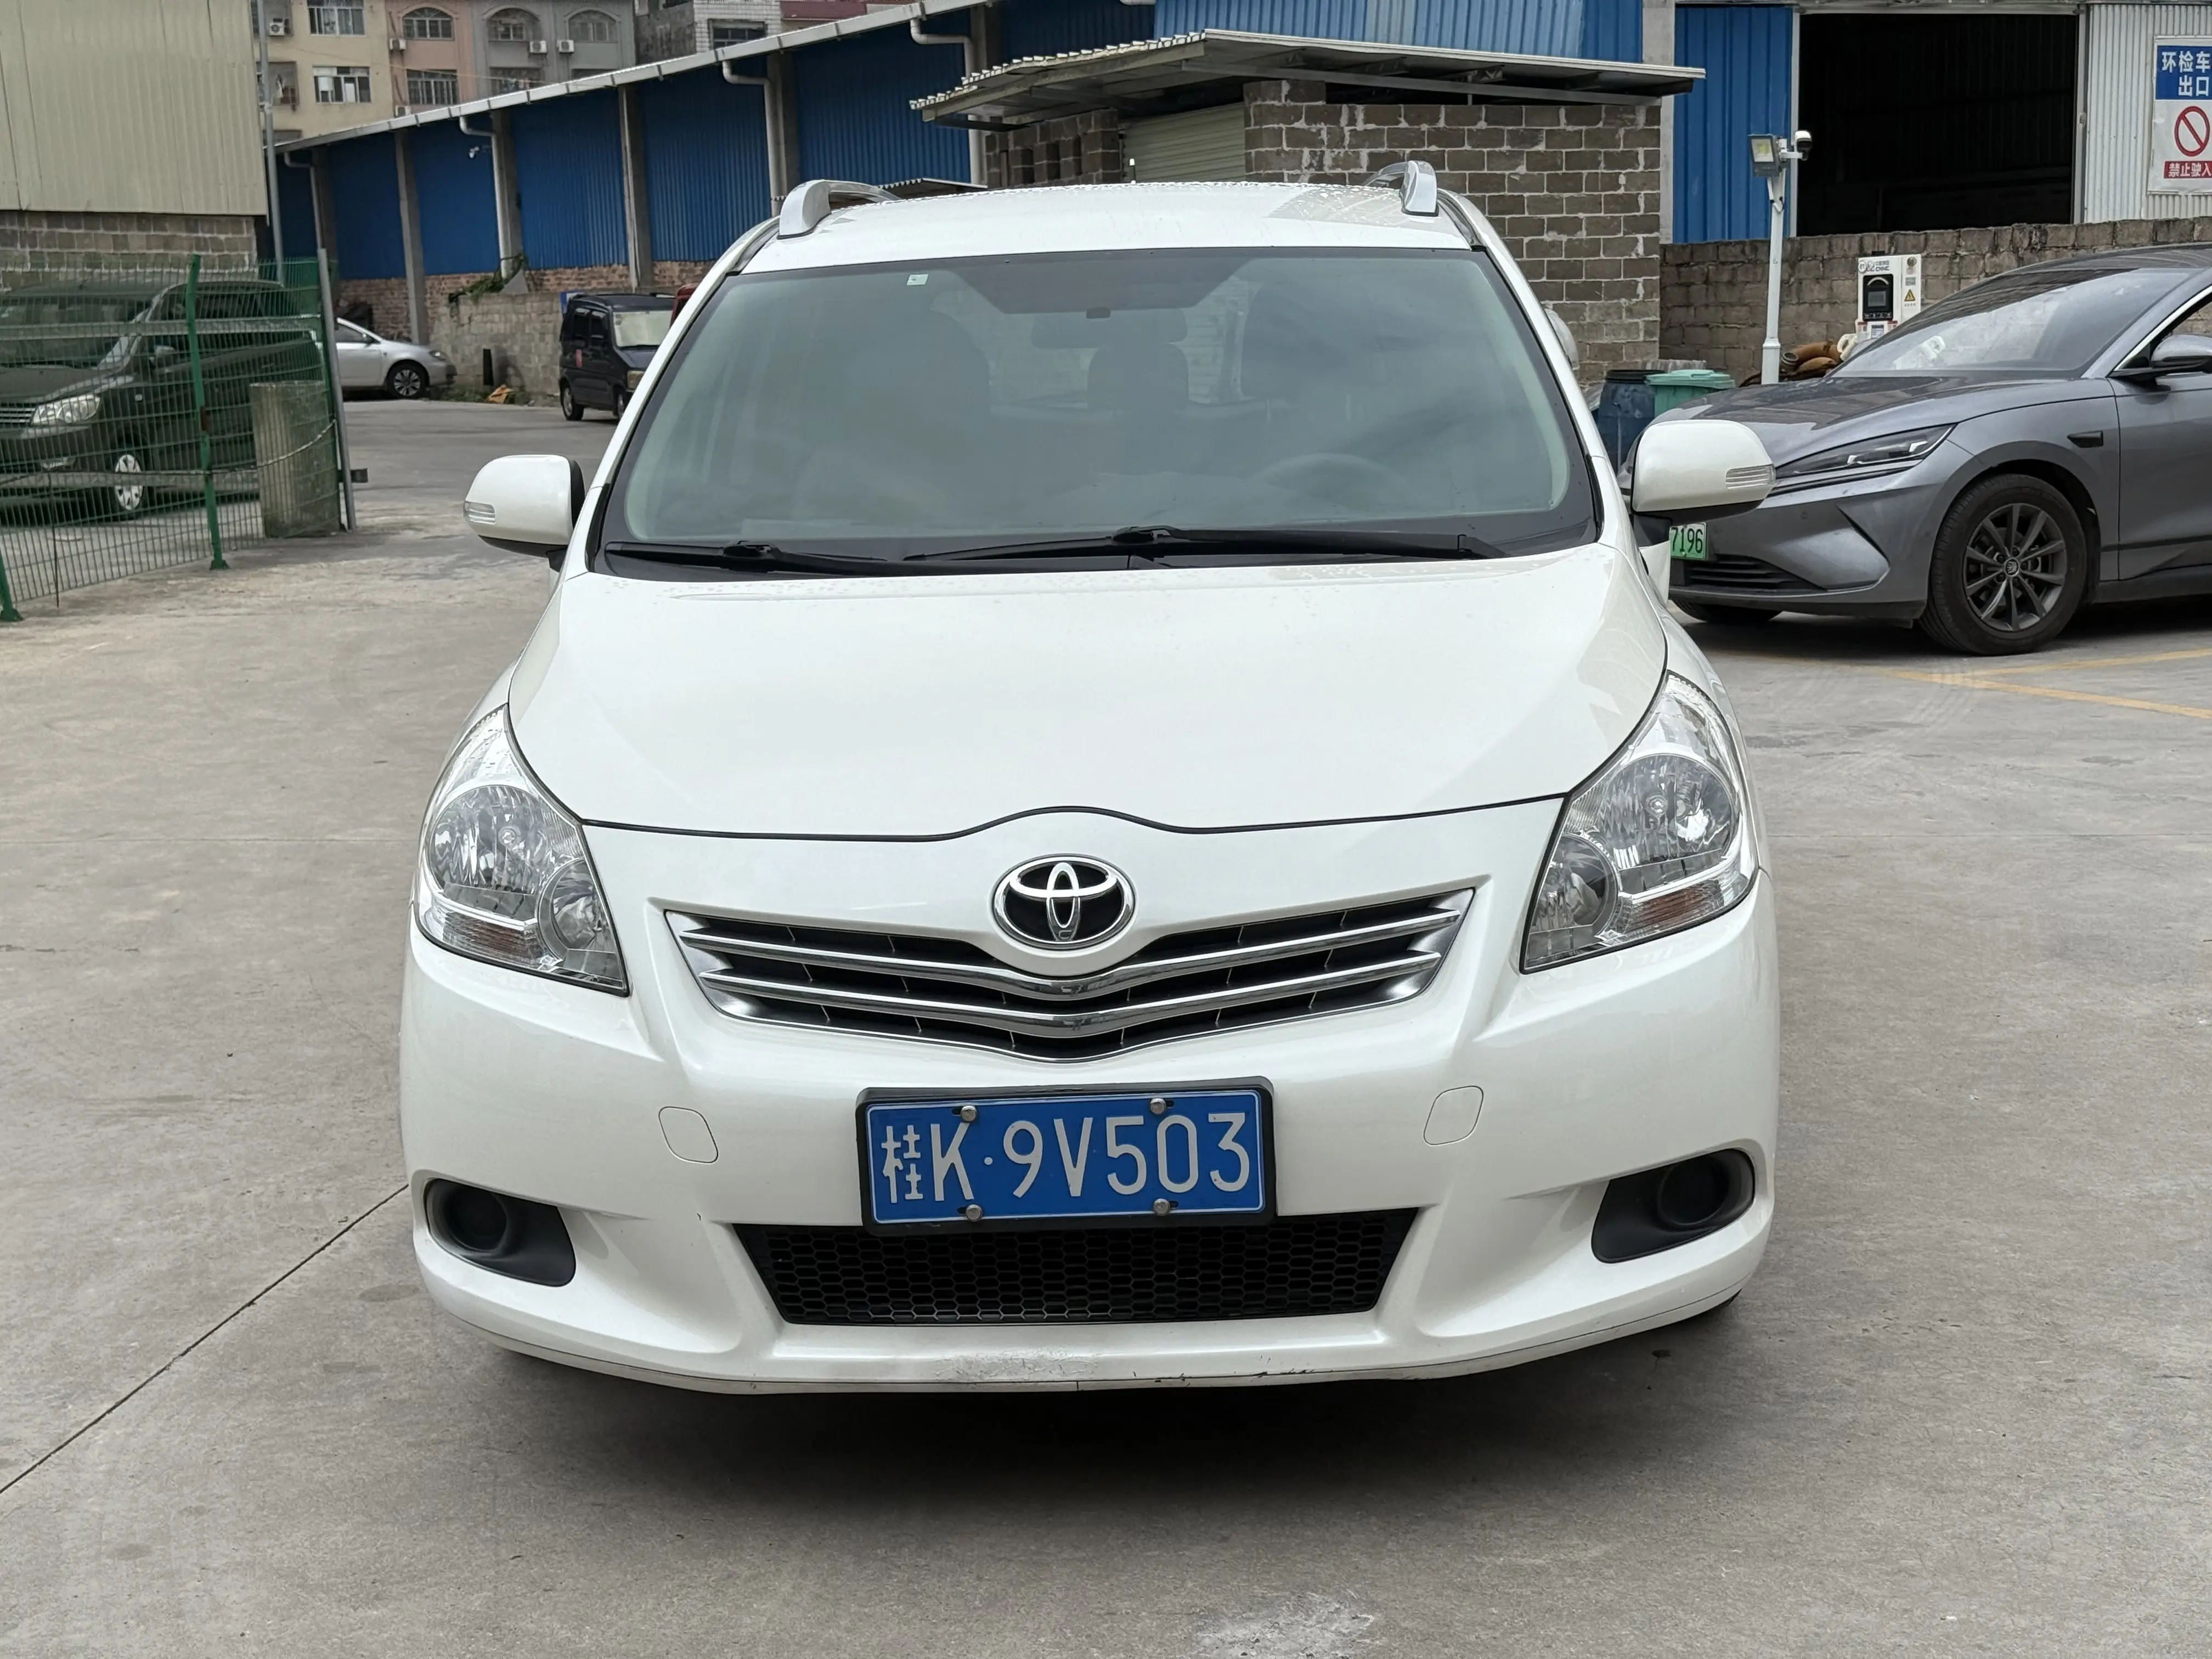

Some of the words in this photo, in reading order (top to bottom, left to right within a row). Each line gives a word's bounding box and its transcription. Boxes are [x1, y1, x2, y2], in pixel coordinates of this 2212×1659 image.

[2162, 51, 2210, 73] 环检车
[2178, 75, 2209, 97] 出口
[2168, 163, 2212, 177] 禁止驶入
[1671, 527, 1703, 554] 7196
